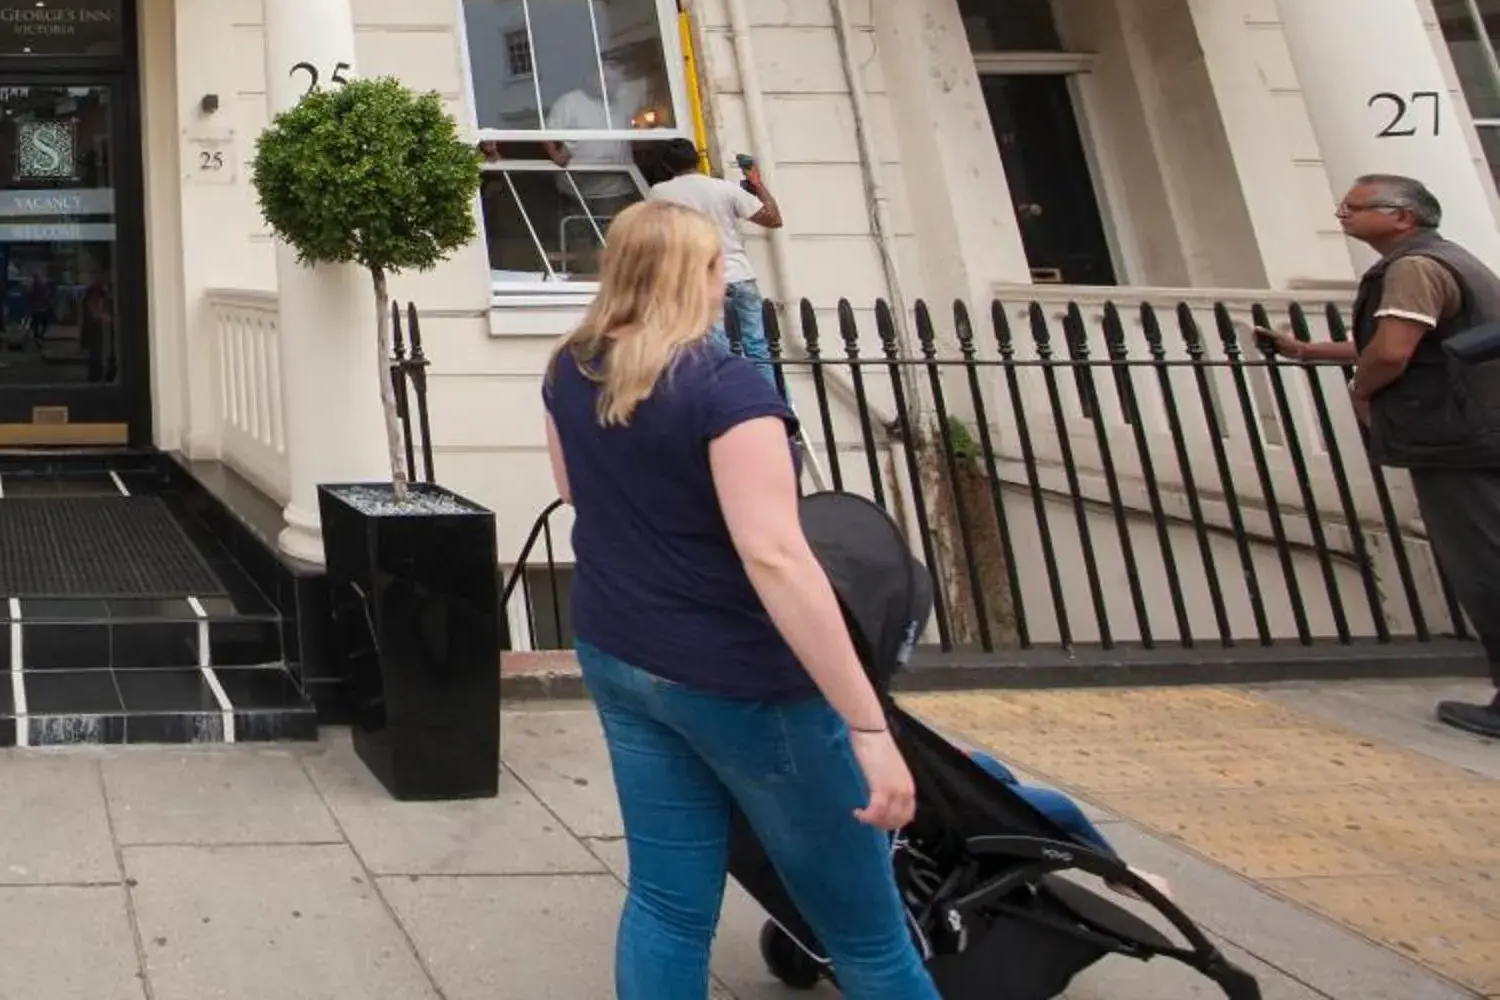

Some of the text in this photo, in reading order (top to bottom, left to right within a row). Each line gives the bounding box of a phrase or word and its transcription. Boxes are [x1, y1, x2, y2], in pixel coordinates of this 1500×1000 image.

[14, 24, 76, 36] VICTORIA
[1367, 91, 1439, 138] 27
[199, 151, 223, 171] 25
[13, 196, 81, 211] VACANCY
